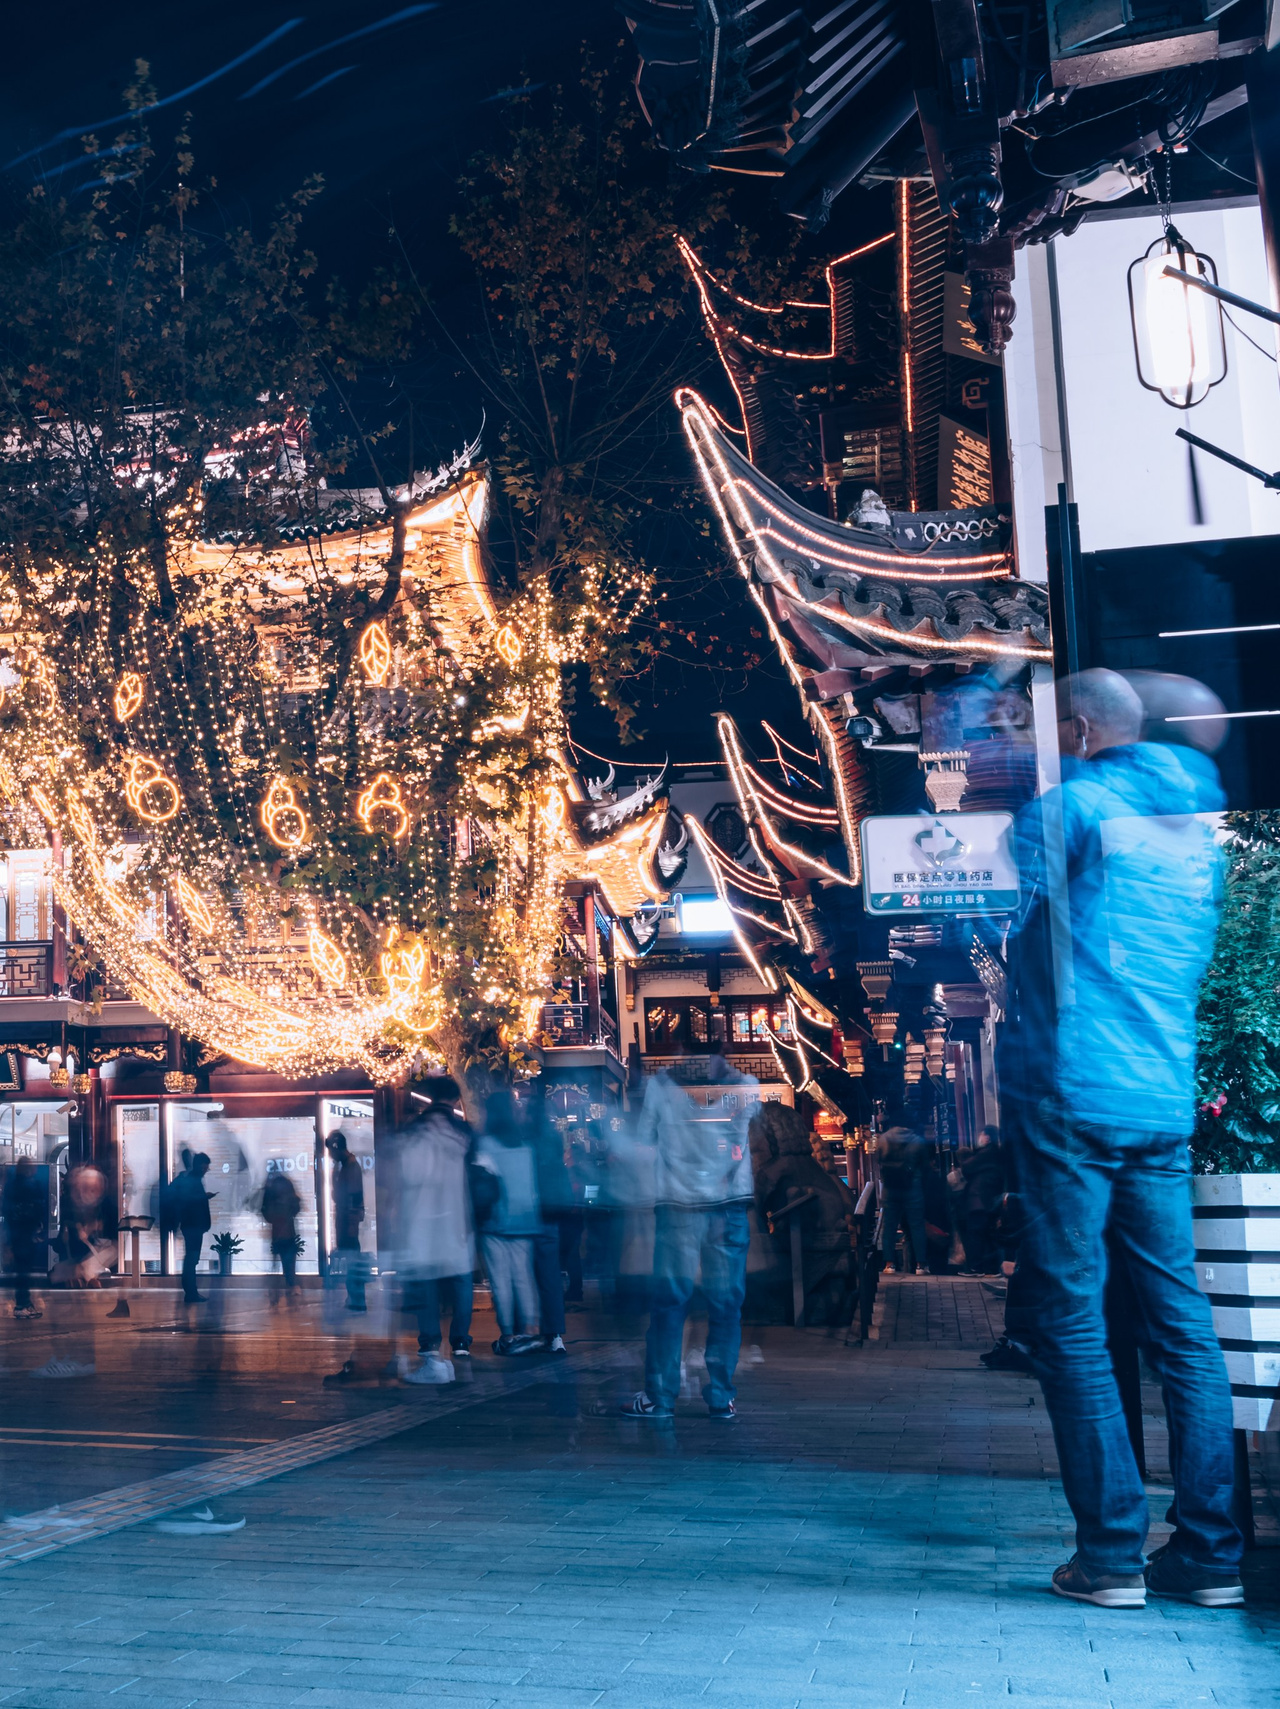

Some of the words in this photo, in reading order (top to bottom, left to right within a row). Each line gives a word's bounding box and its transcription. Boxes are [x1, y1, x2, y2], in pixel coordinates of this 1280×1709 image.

[894, 870, 993, 883] 医保定点零售药店
